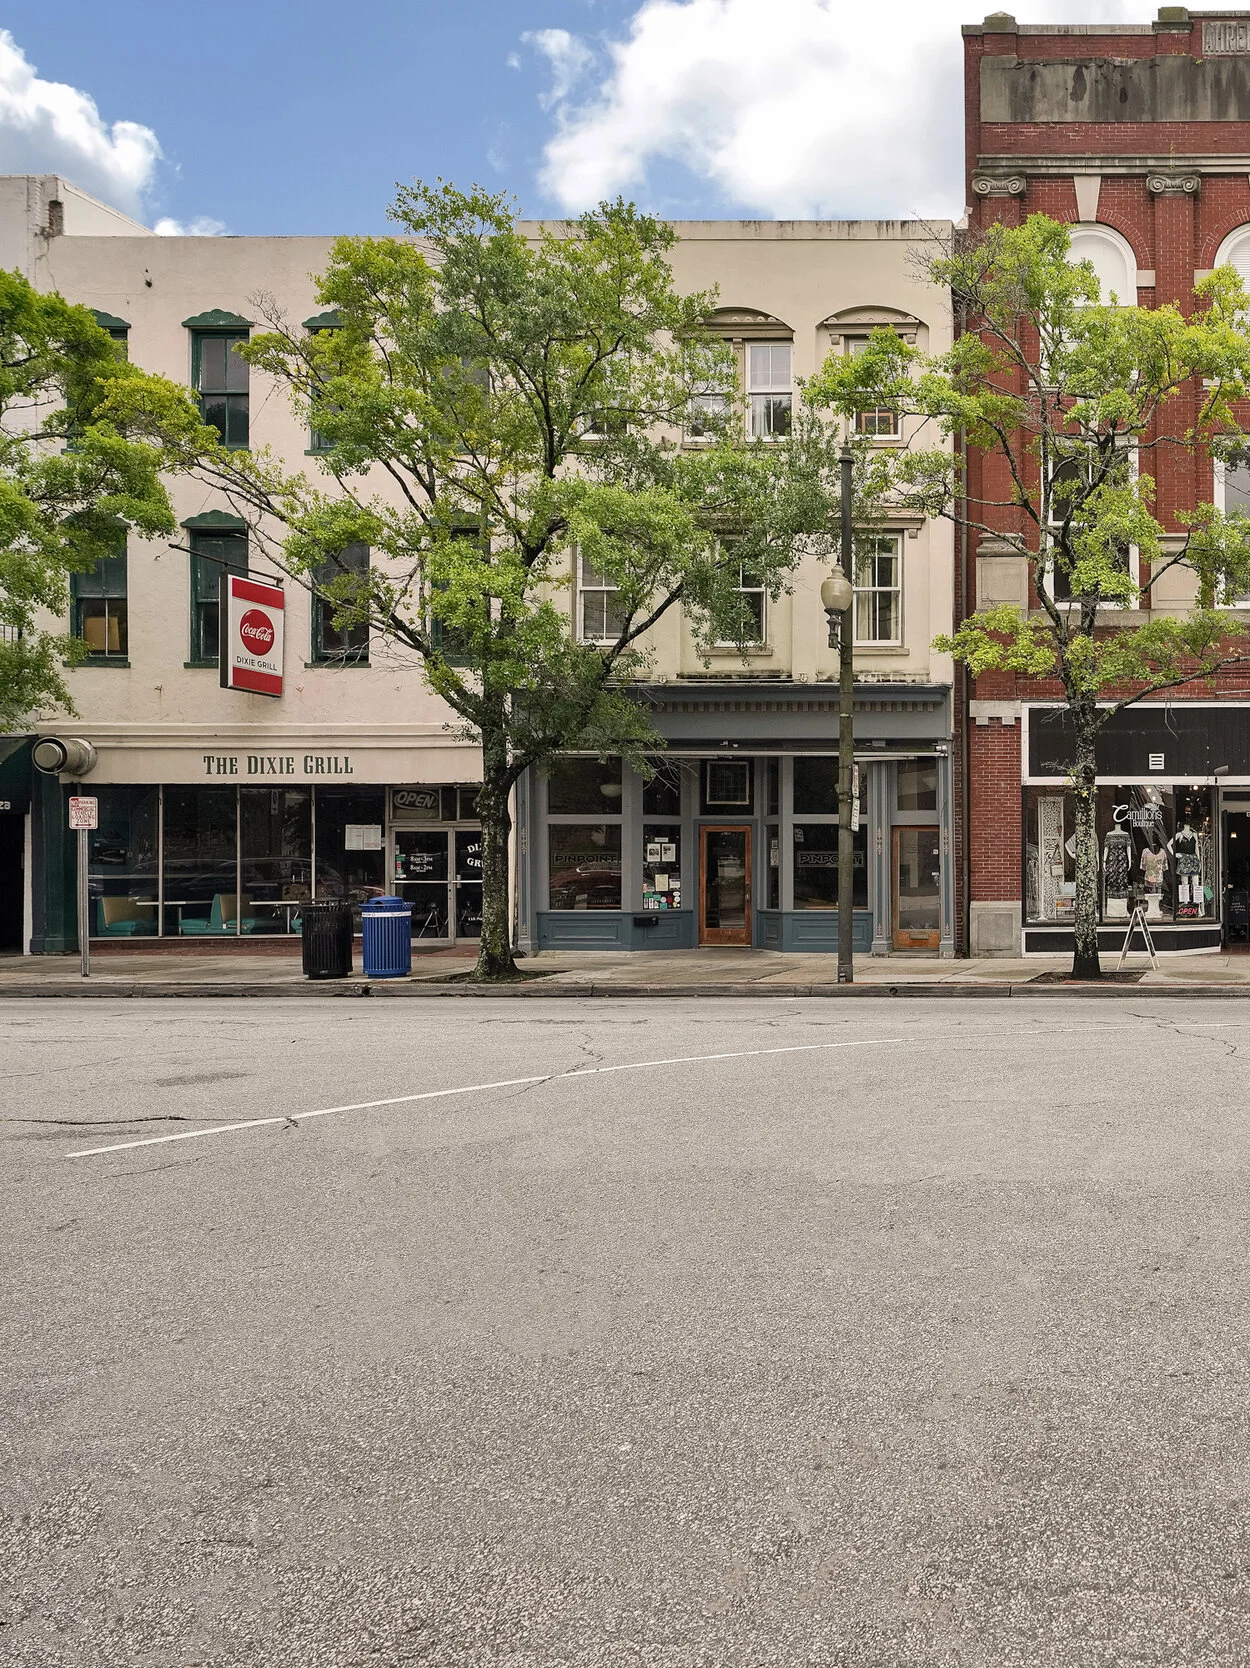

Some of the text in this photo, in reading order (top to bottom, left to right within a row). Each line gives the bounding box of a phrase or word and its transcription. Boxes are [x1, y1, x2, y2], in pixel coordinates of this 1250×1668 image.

[236, 655, 278, 671] DIXIE GRILL
[203, 755, 354, 775] THE DIXIE GRILL
[395, 791, 435, 808] OPEN
[1132, 819, 1155, 829] Boutique
[555, 854, 617, 863] PINPOINT
[1178, 907, 1198, 915] OPEN
